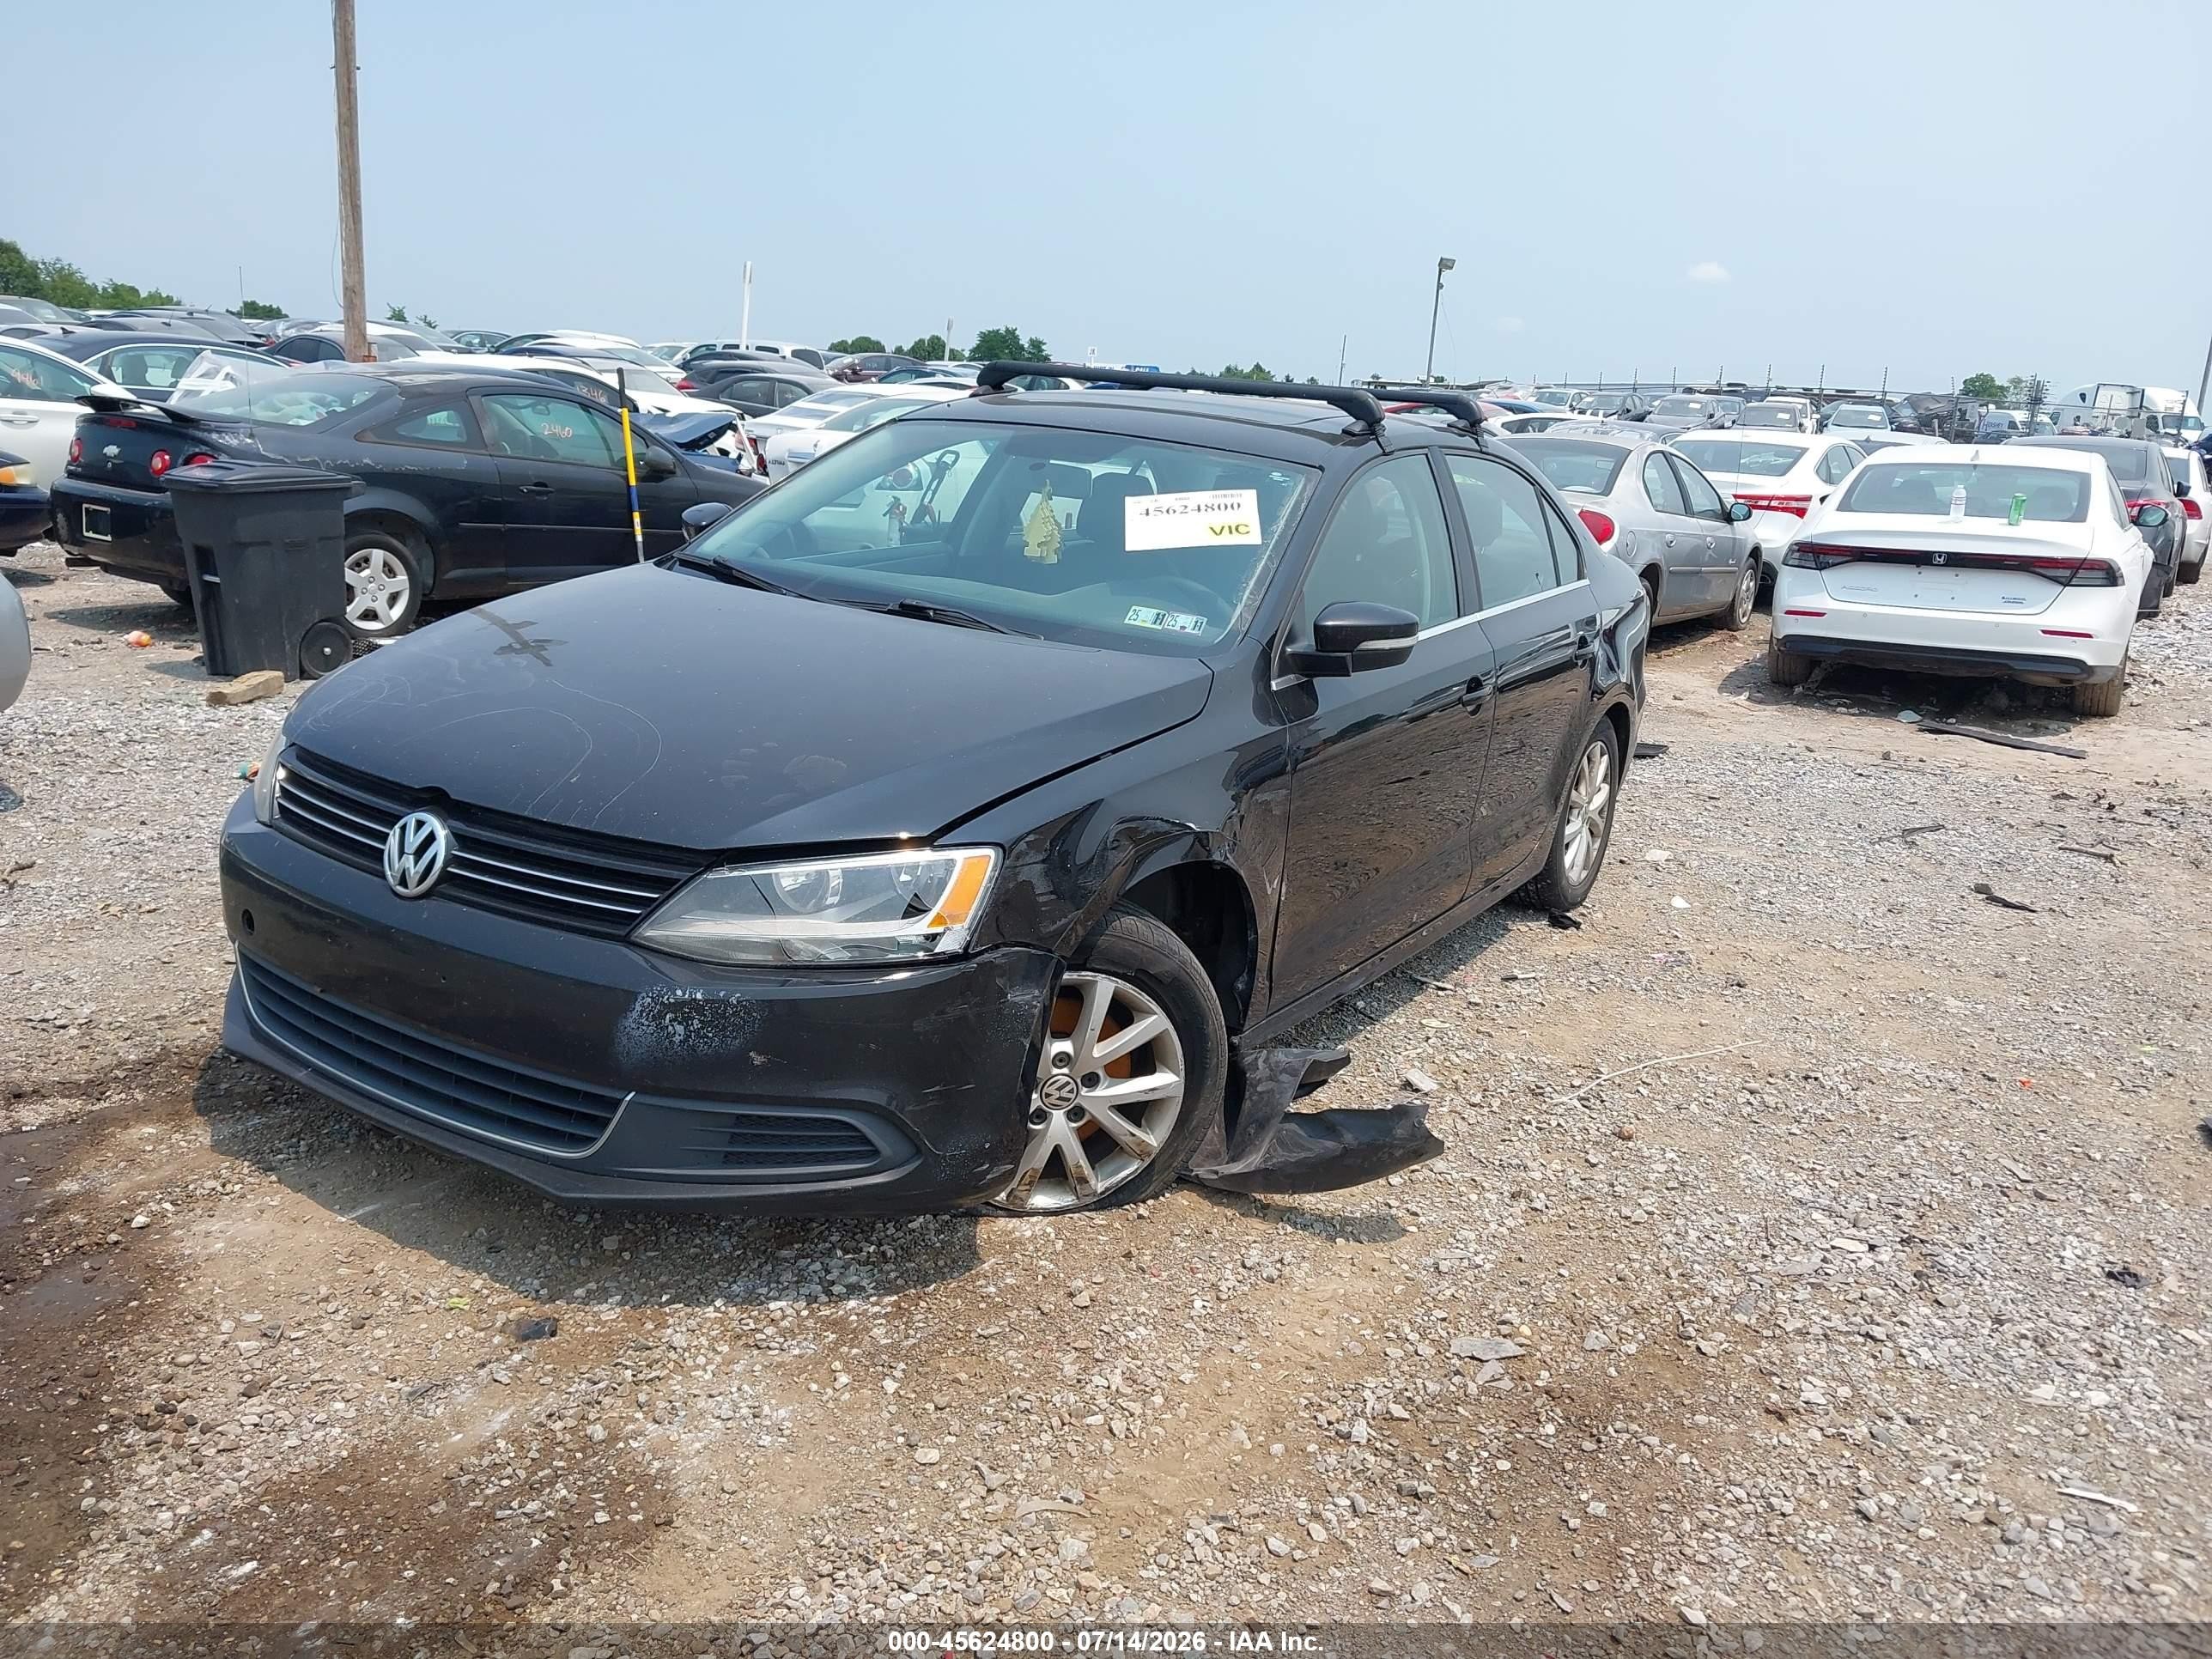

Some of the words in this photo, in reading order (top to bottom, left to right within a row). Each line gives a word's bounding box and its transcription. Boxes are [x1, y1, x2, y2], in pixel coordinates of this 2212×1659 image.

[541, 422, 573, 439] 2460
[1139, 501, 1242, 517] 45624800
[1209, 523, 1251, 537] VIC
[1128, 609, 1142, 622] 25
[1167, 615, 1180, 628] 25
